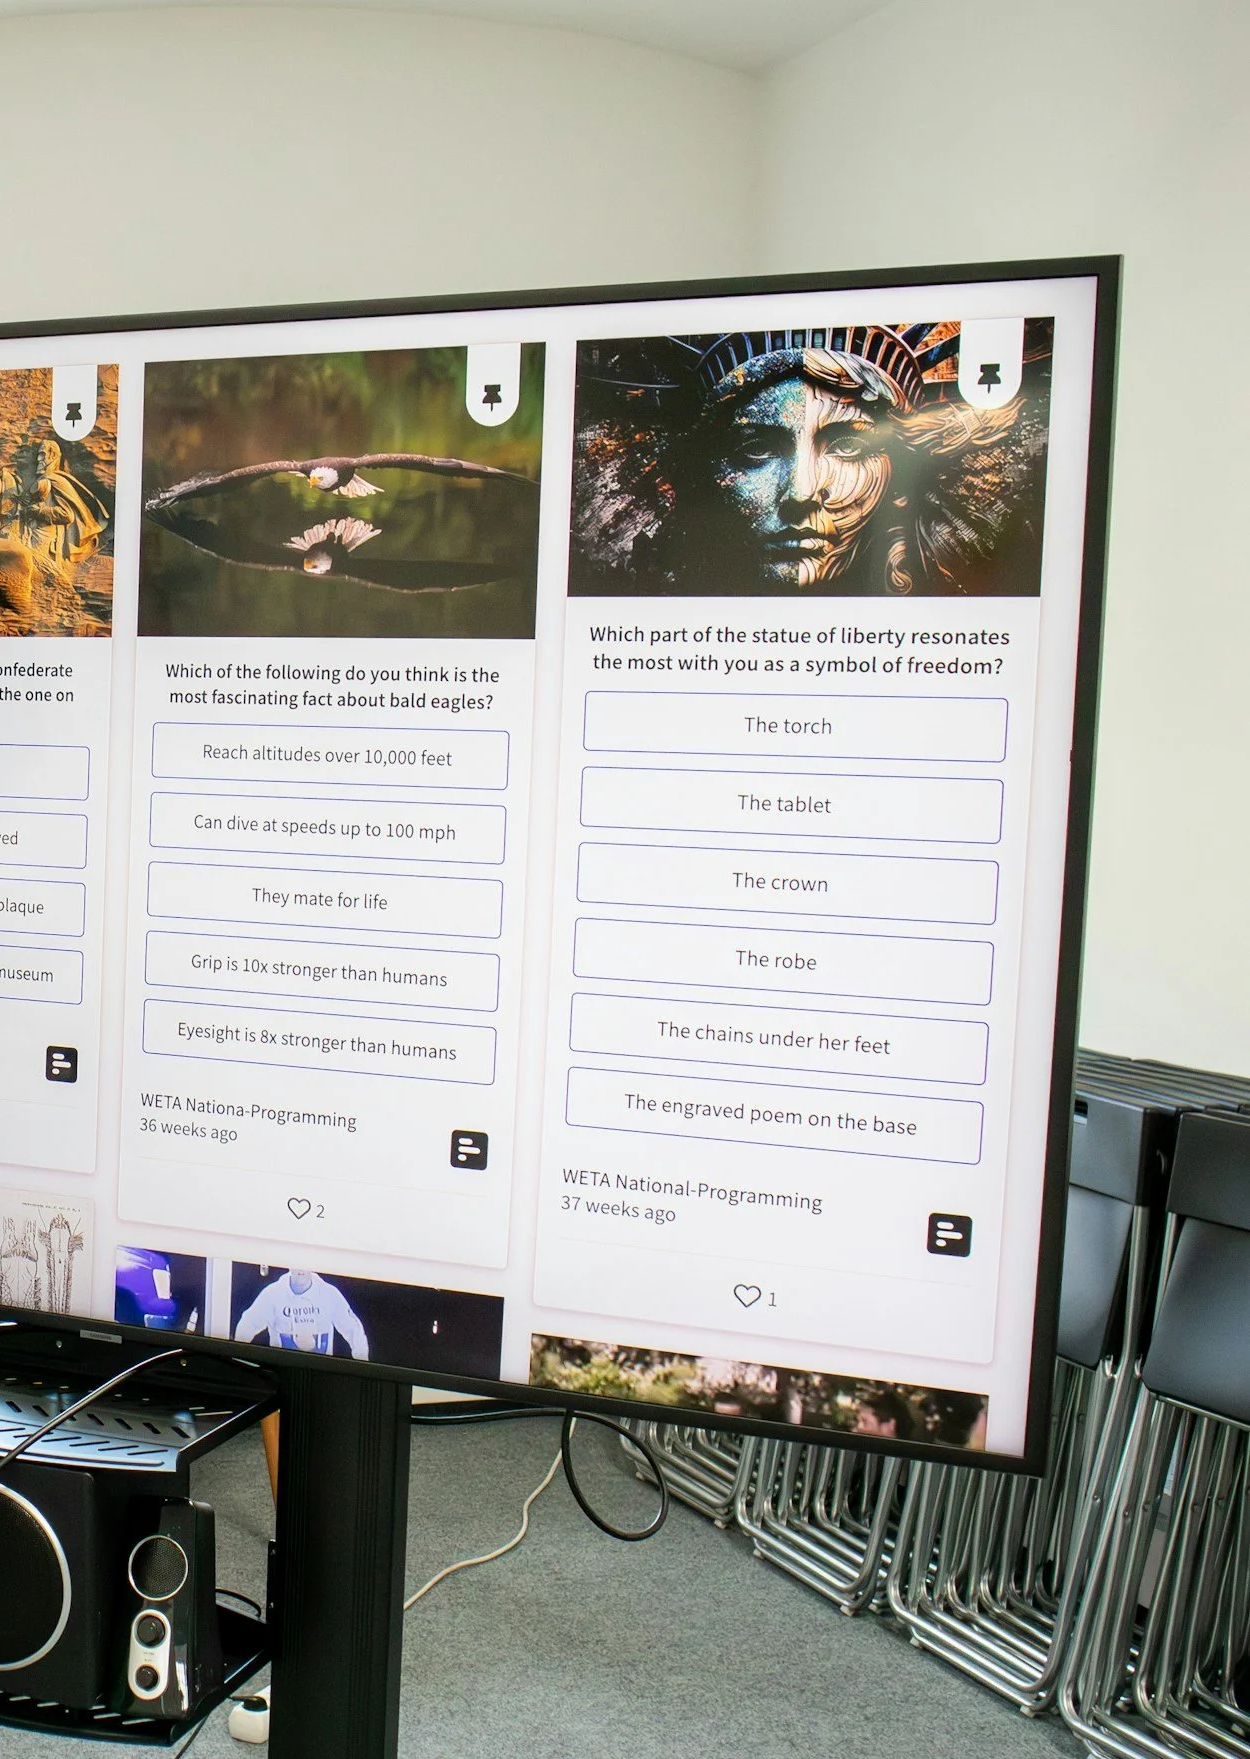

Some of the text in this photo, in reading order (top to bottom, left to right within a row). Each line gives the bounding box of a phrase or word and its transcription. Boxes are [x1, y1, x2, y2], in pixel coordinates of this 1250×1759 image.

[590, 625, 1010, 648] Which part of the statue of liberty resonates
[166, 663, 500, 685] Which of the following do you think is the
[593, 653, 1003, 676] the most with you as a symbol of freedom?
[25, 690, 52, 701] one
[56, 691, 74, 701] on
[170, 688, 494, 713] most fascinating fact about bald eagles?
[203, 744, 453, 767] Reach altitudes over 10,000 feet
[194, 814, 456, 843] Can dive at speeds up to 100 mph
[252, 887, 388, 910] They mate for life
[191, 954, 448, 987] Grip is 10x stronger than humans
[178, 1022, 457, 1060] Eyesight is 8x stronger than humans
[657, 1021, 891, 1054] The chains under her feet
[140, 1093, 357, 1132] WETA Nationa-Programming
[624, 1093, 917, 1135] The engraved poem on the base
[139, 1117, 238, 1144] 36 weeks ago
[316, 1204, 325, 1218] 2
[768, 1292, 777, 1307] 1
